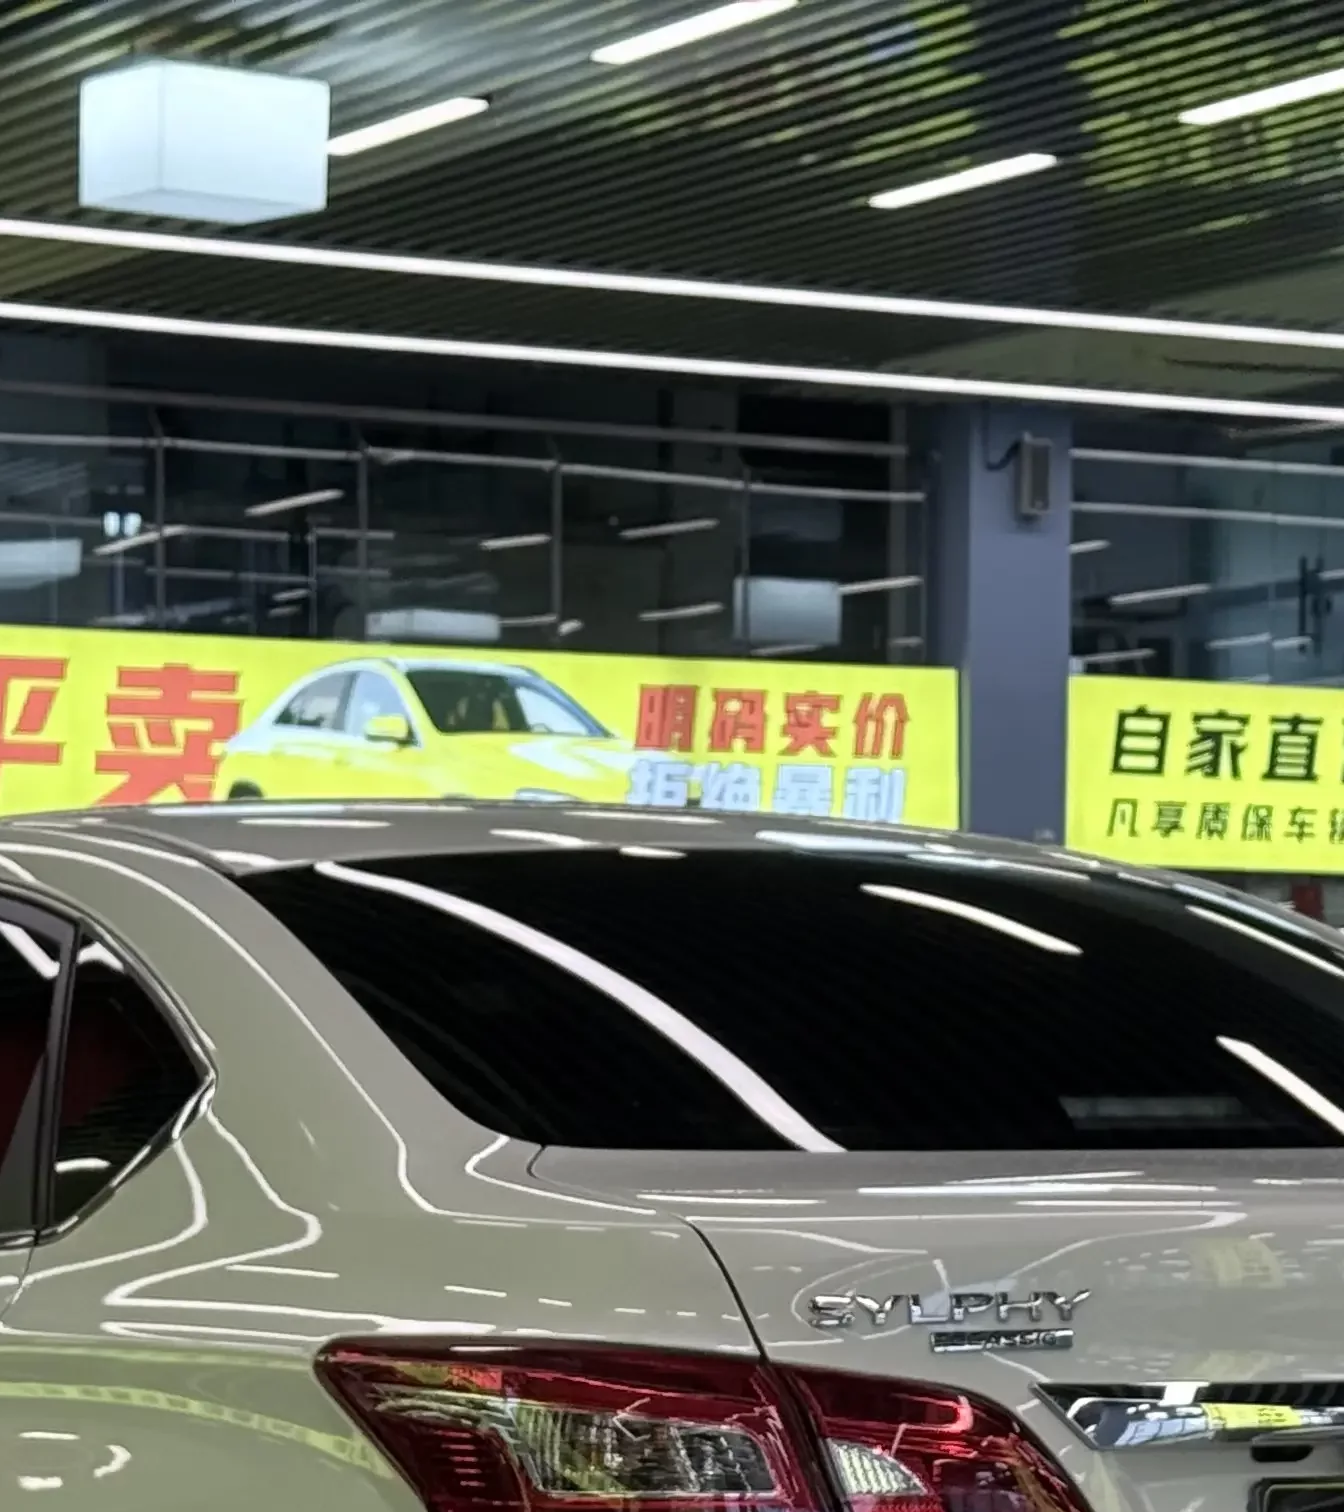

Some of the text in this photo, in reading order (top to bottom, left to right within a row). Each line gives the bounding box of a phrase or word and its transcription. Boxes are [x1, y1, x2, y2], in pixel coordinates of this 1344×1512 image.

[635, 684, 910, 759] 明码实价
[809, 1289, 1091, 1328] SYLPHY
